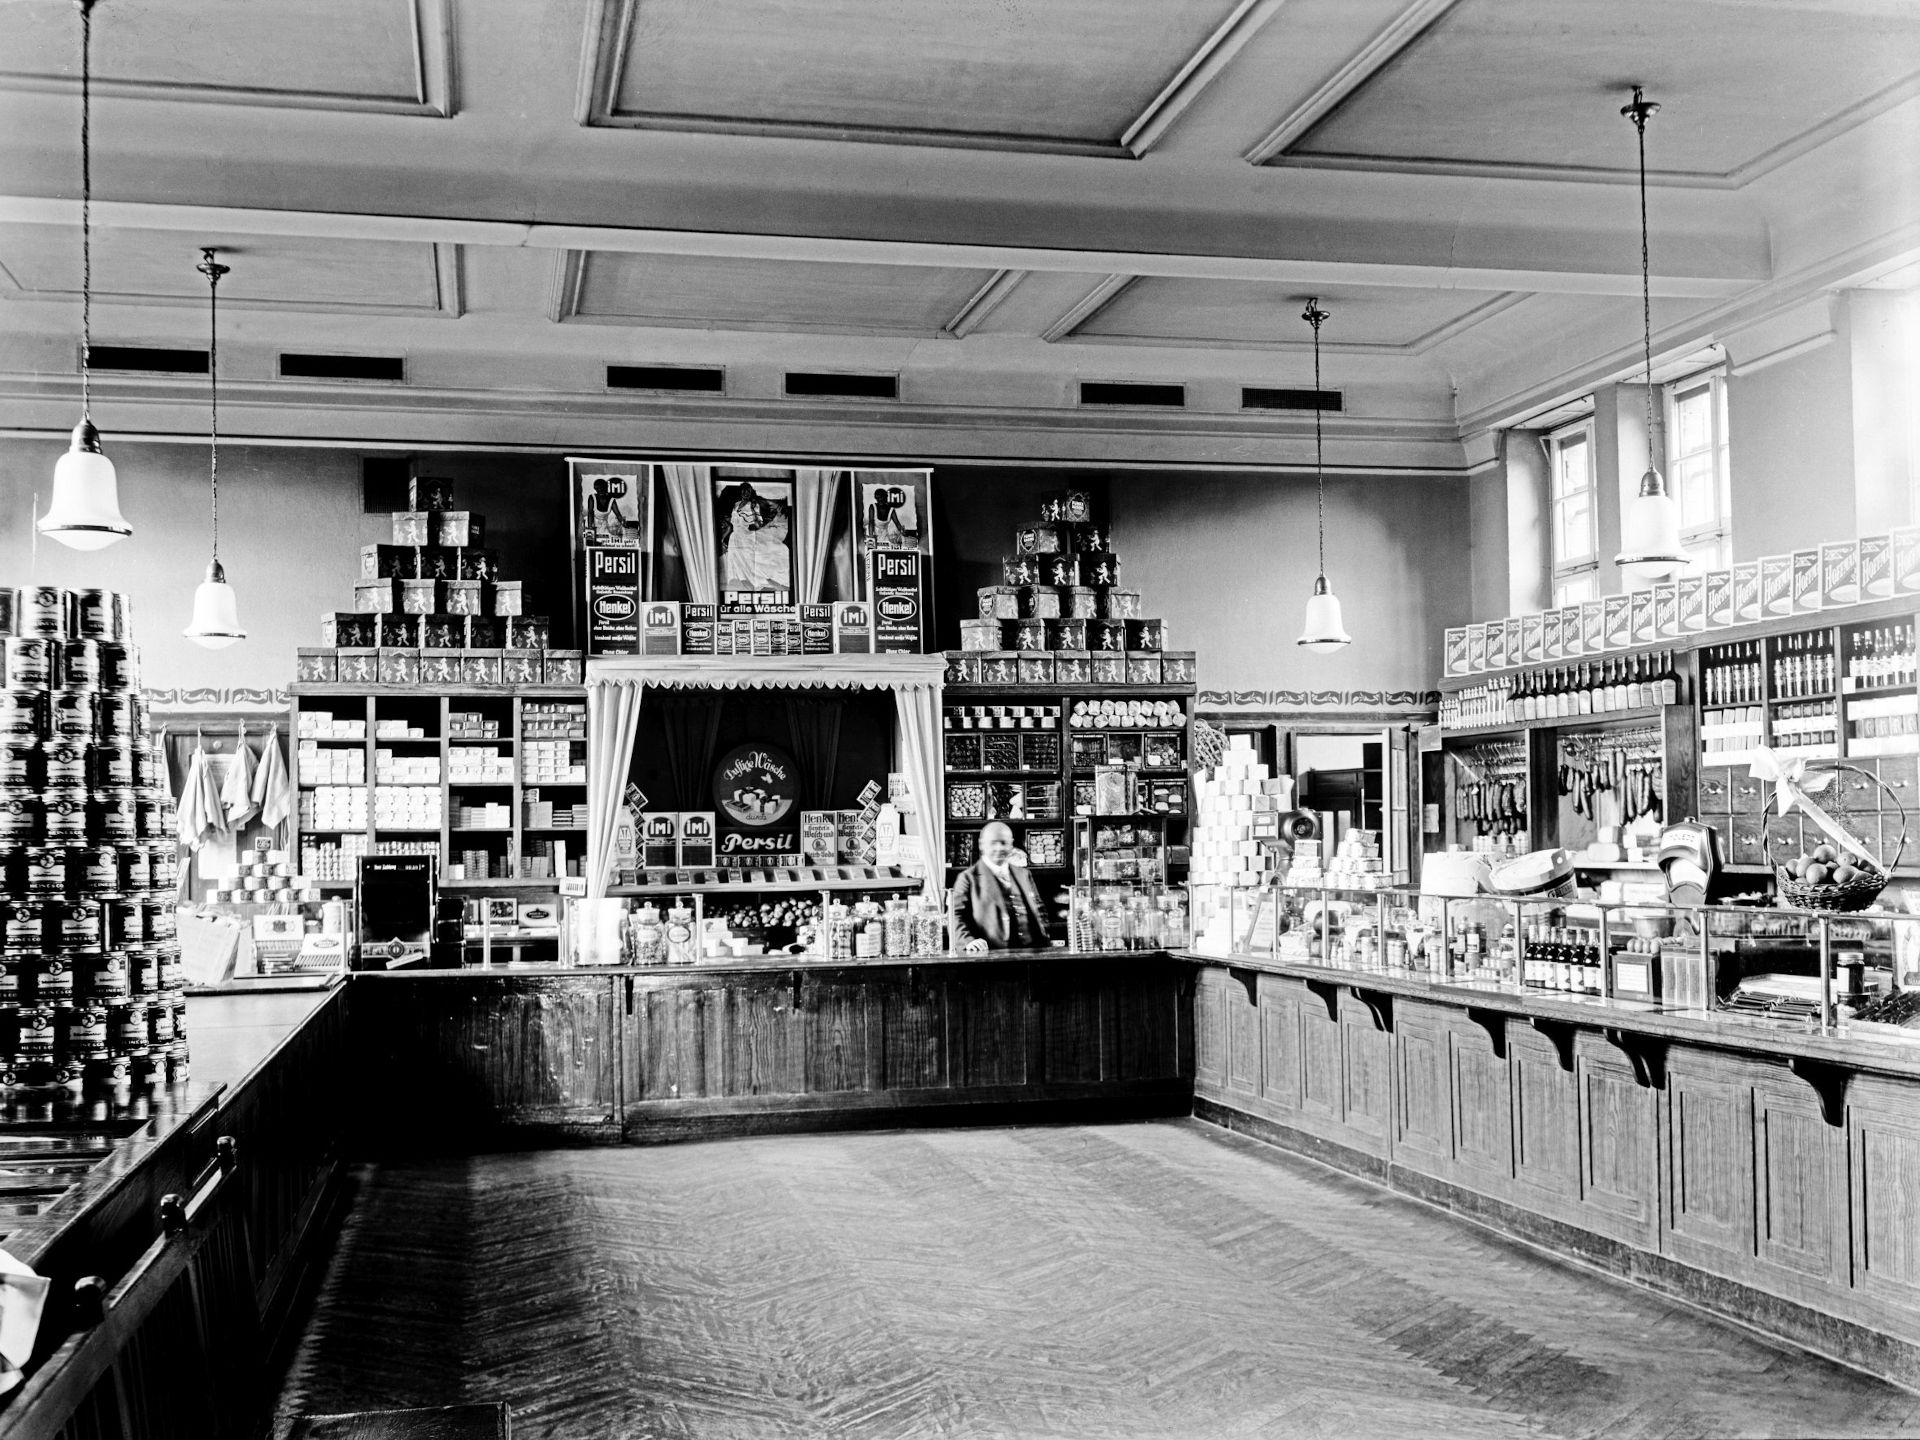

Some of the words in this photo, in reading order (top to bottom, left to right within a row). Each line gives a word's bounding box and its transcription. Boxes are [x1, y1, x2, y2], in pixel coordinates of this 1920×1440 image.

[595, 551, 636, 578] Persil
[878, 554, 916, 579] Persil
[724, 591, 789, 605] Persil
[599, 601, 631, 615] Henkel
[685, 605, 713, 619] Persil
[720, 605, 730, 613] ür
[733, 605, 752, 613] alle
[754, 604, 796, 613] Wäsche
[803, 605, 831, 619] Persil
[882, 602, 912, 615] Henkel
[649, 609, 673, 625] iMi
[843, 609, 865, 624] iMi
[748, 751, 786, 780] Wäsche
[650, 820, 672, 834] iMi
[686, 820, 708, 834] iMi
[721, 833, 793, 852] Persil
